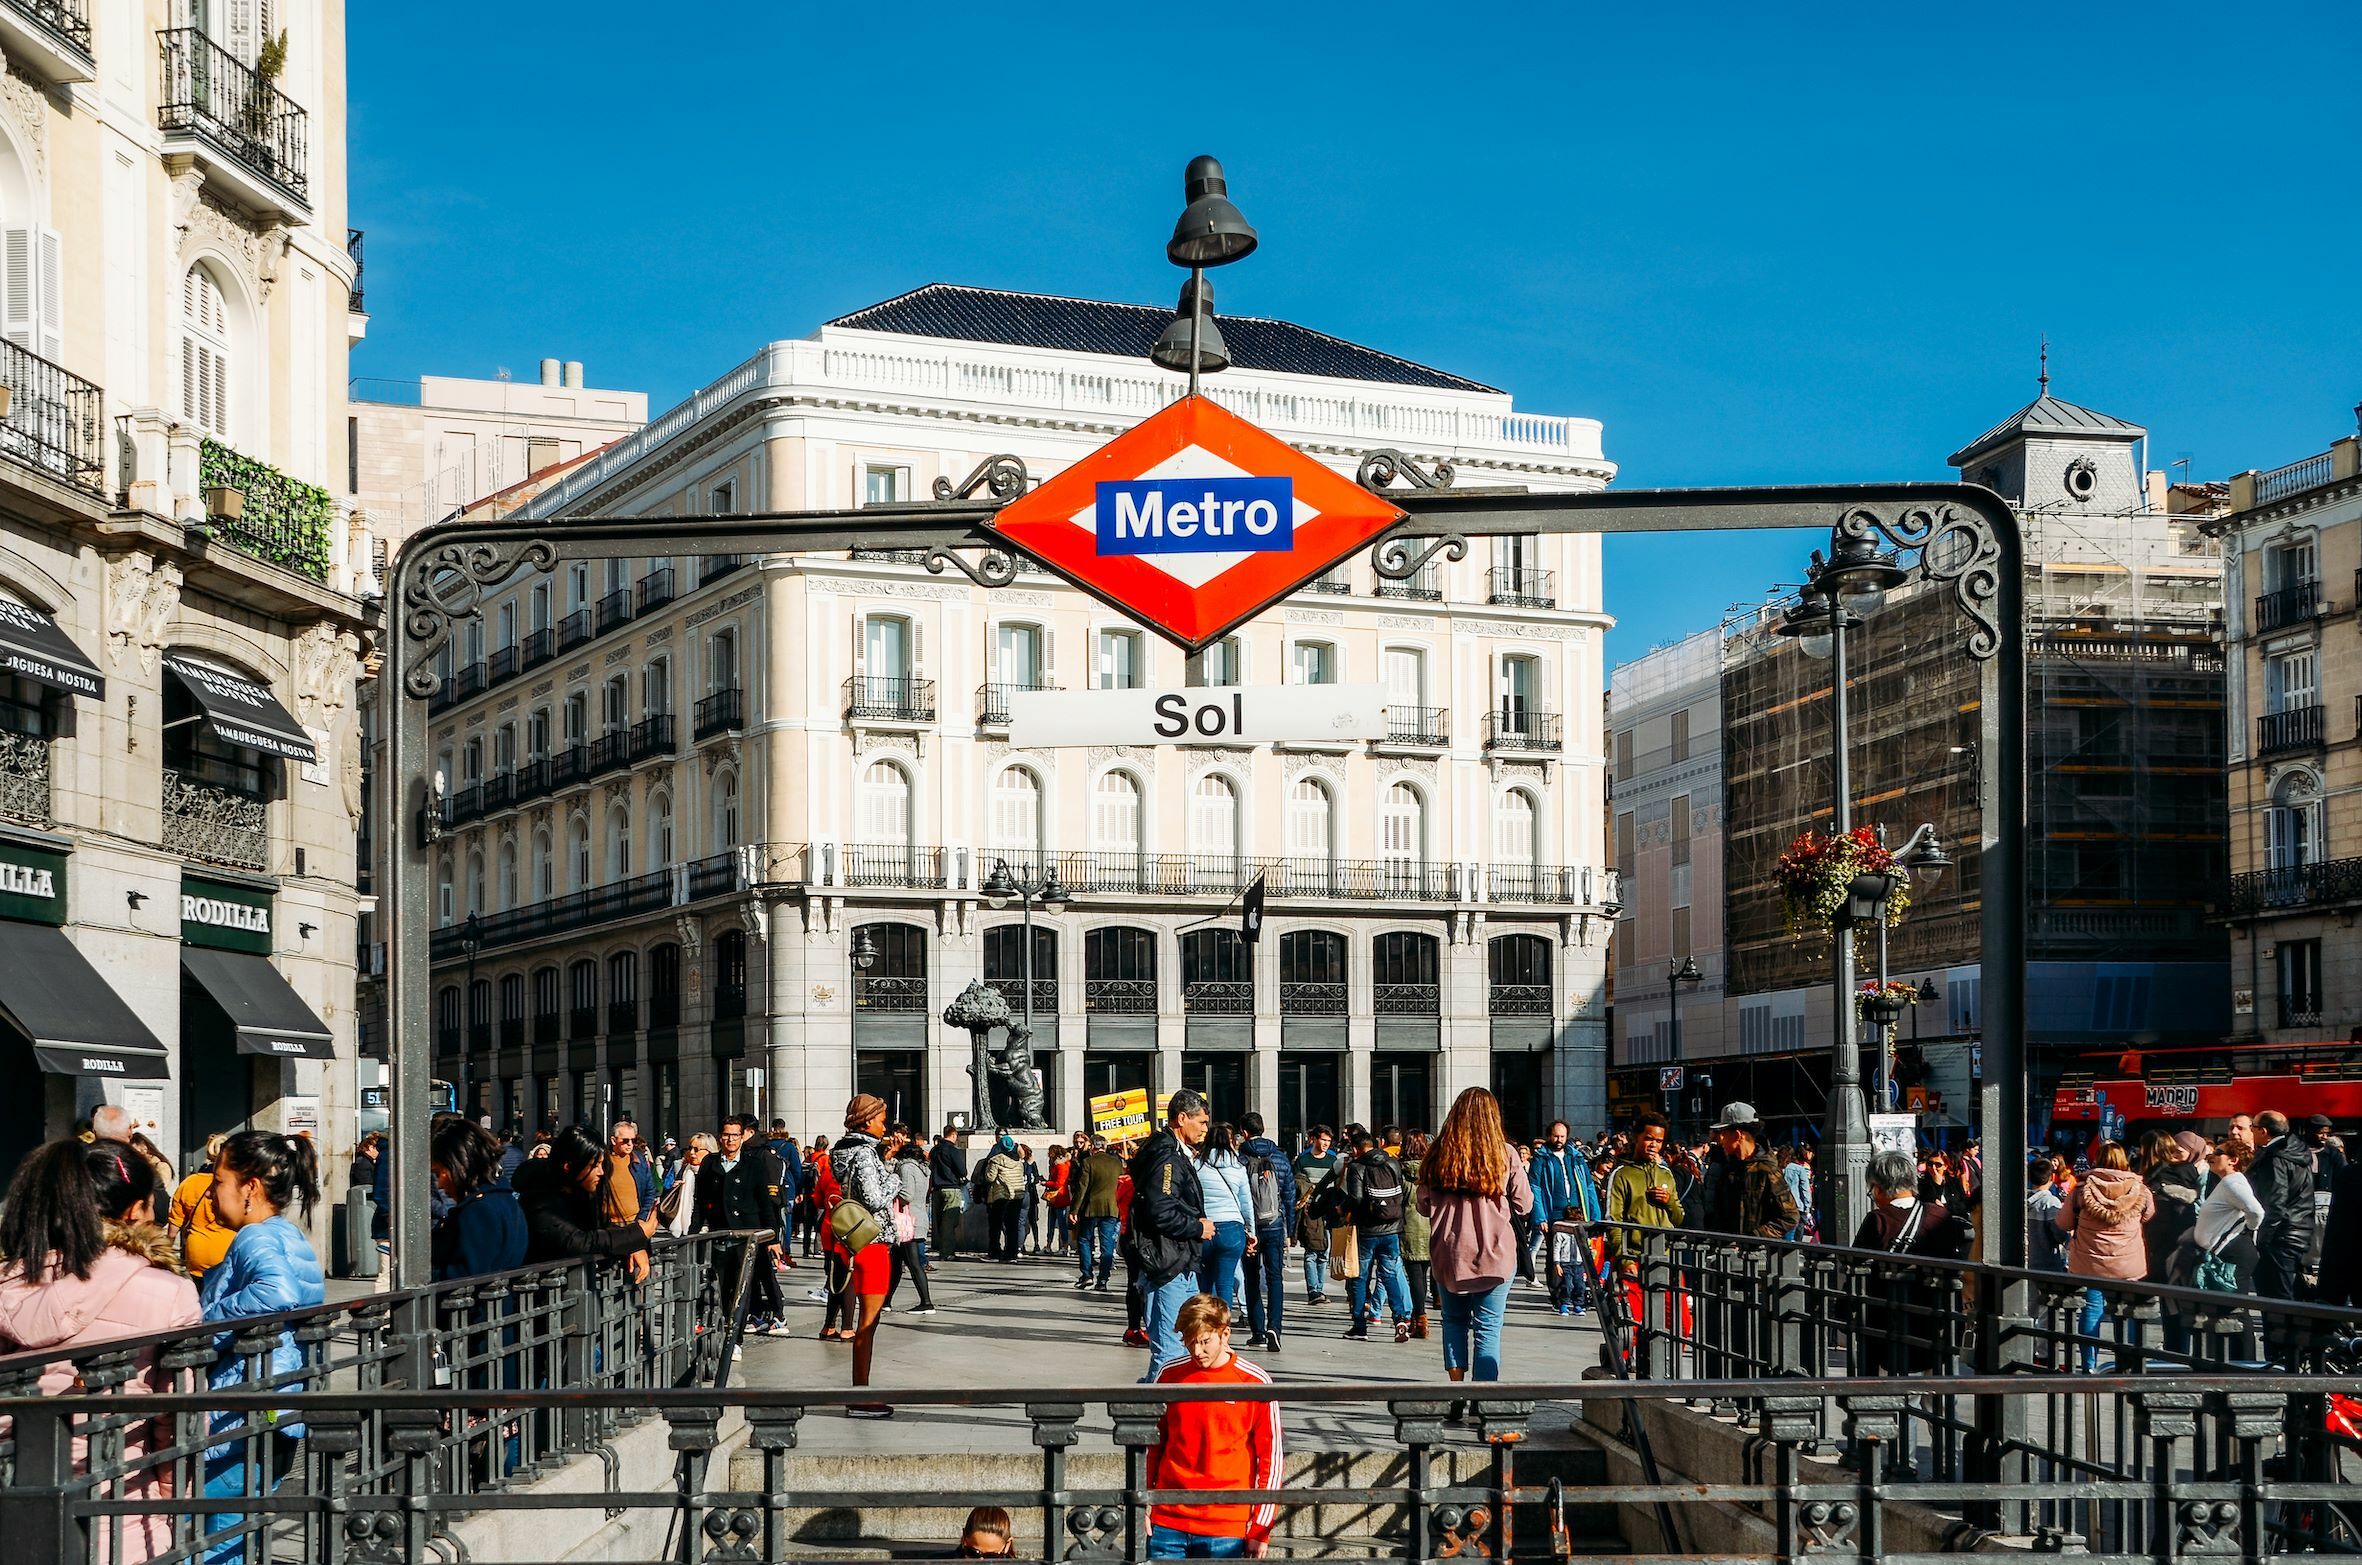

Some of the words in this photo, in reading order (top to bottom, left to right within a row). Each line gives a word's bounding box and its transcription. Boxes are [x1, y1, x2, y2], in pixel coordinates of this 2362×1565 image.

[1115, 491, 1278, 539] Metro
[57, 670, 97, 692] NOSTRA
[166, 659, 275, 702] HAMBURGUESA
[202, 681, 264, 709] NOSTRA
[1152, 692, 1243, 739] Sol
[213, 724, 279, 751] HAMBURGUESA
[280, 742, 316, 760] NOSTRA
[180, 894, 270, 933] RODILLA
[270, 1041, 307, 1053] RODILLA
[82, 1058, 126, 1072] RODILLA
[367, 1092, 381, 1104] 51
[2145, 1086, 2199, 1107] MADRID
[1099, 1117, 1122, 1131] FREE
[1122, 1113, 1145, 1126] TOUR
